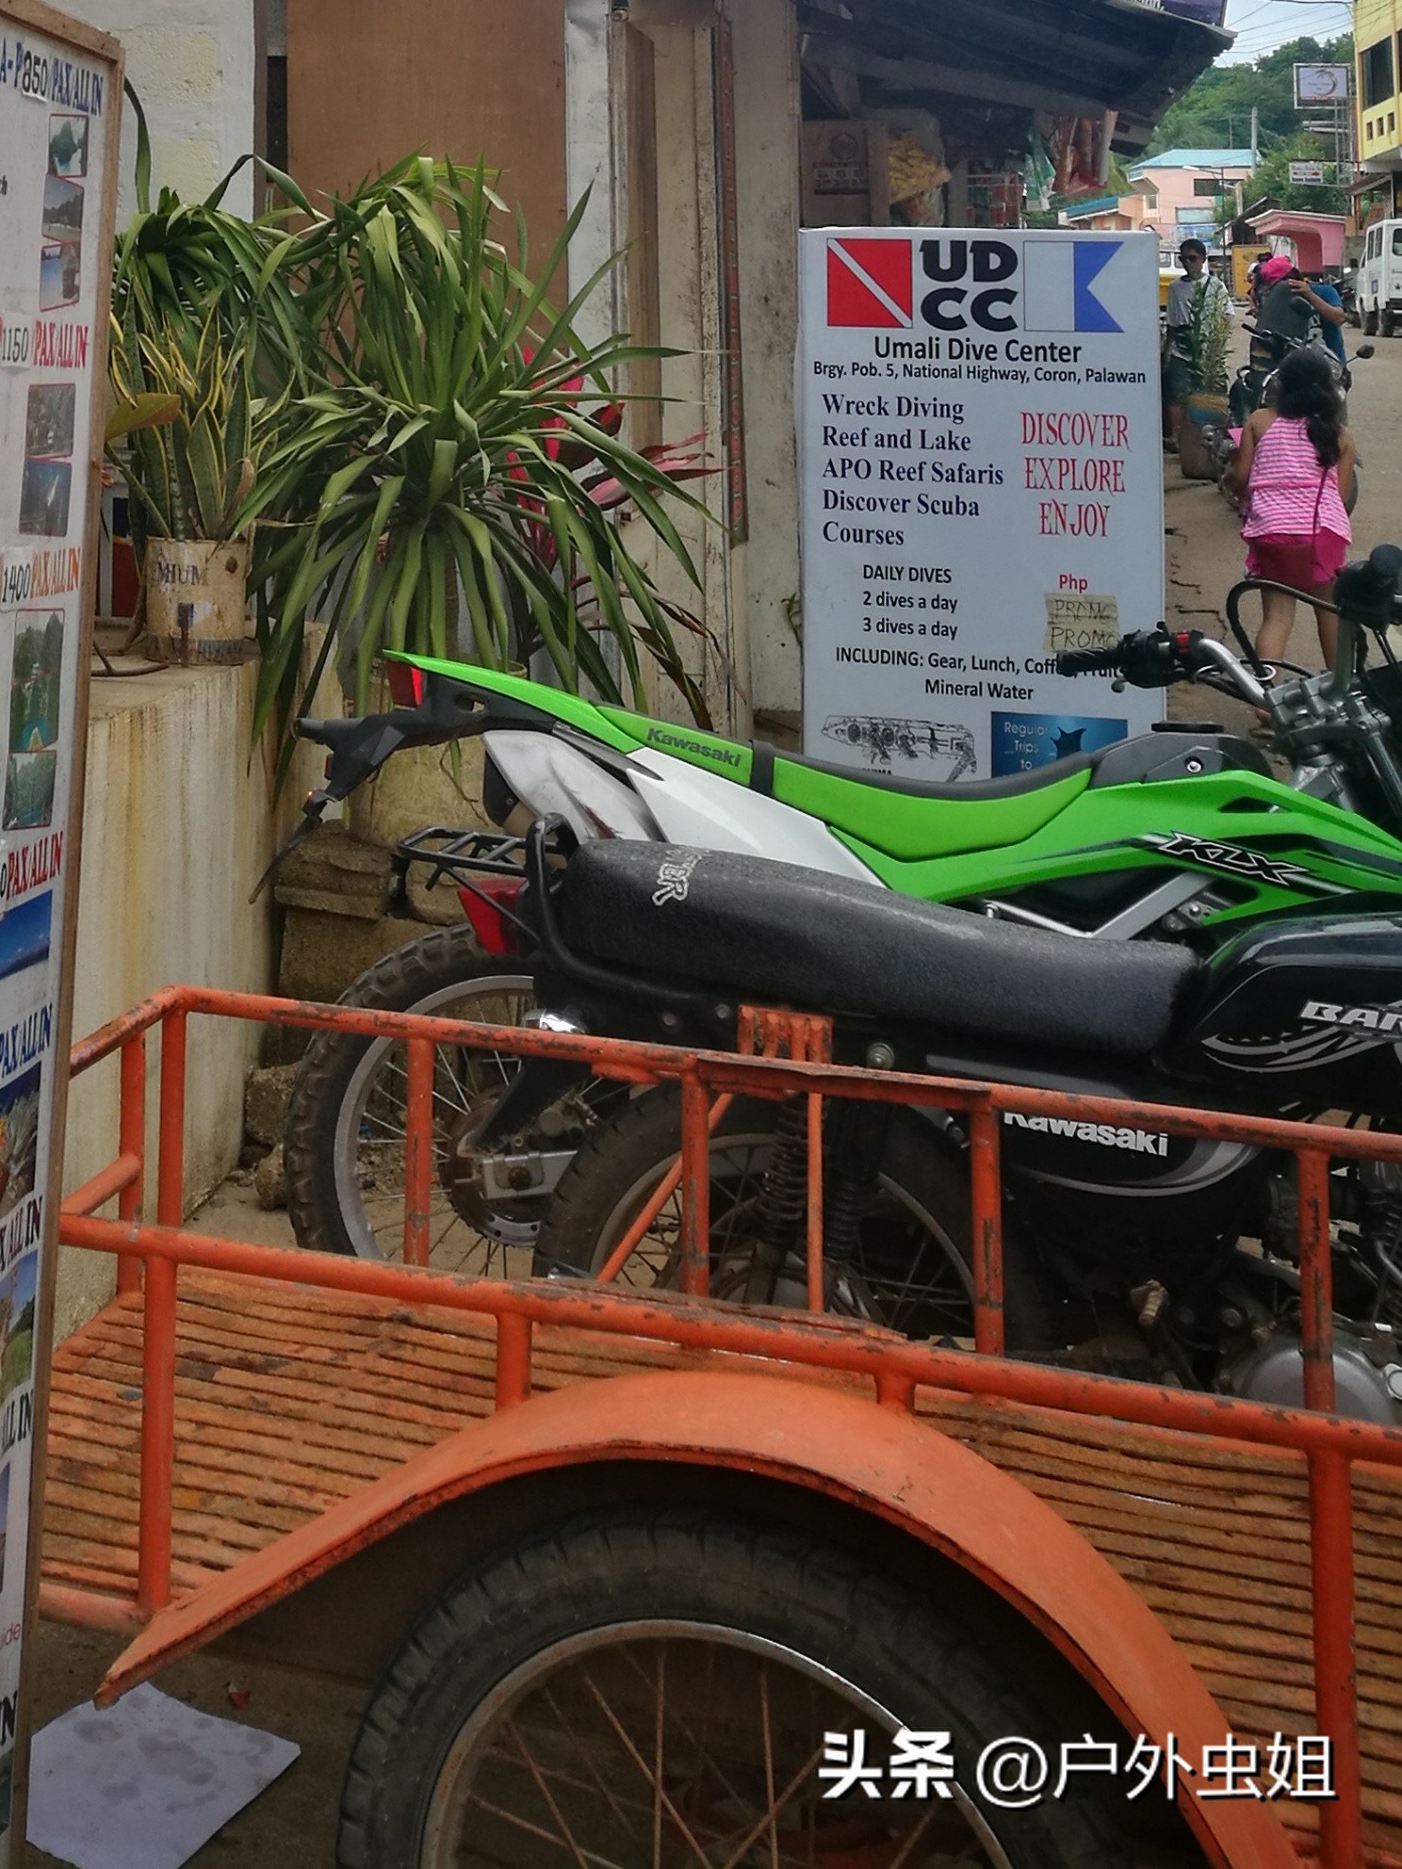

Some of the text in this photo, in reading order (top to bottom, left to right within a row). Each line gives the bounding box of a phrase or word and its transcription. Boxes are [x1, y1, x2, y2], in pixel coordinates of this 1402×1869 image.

[919, 240, 1018, 282] UD
[921, 287, 1018, 331] CC
[874, 336, 1081, 363] Umali Dive Center
[813, 362, 1146, 384] Brgy. Pob. 5, National Highway, Coron, Palawan
[822, 394, 964, 424] Wreck Diving
[822, 426, 971, 451] Reef and Lake
[1020, 411, 1132, 452] DISCOVER
[822, 458, 1003, 485] APO Reef Safaris
[1024, 457, 1125, 497] EXPLORE
[823, 489, 979, 516] Discover Scuba
[1039, 499, 1110, 537] ENJOY
[823, 521, 904, 545] Courses
[863, 565, 951, 583] DAILY DIVES
[1059, 574, 1088, 593] Php
[863, 591, 957, 613] 2 dives a day
[863, 617, 957, 640] 3 dives a day
[836, 648, 923, 666] INCLUDING:
[928, 654, 966, 671] Gear,
[972, 656, 1020, 675] Lunch,
[925, 680, 1033, 700] Mineral Water
[647, 727, 742, 767] Kawasaki
[1159, 831, 1309, 886] KLX
